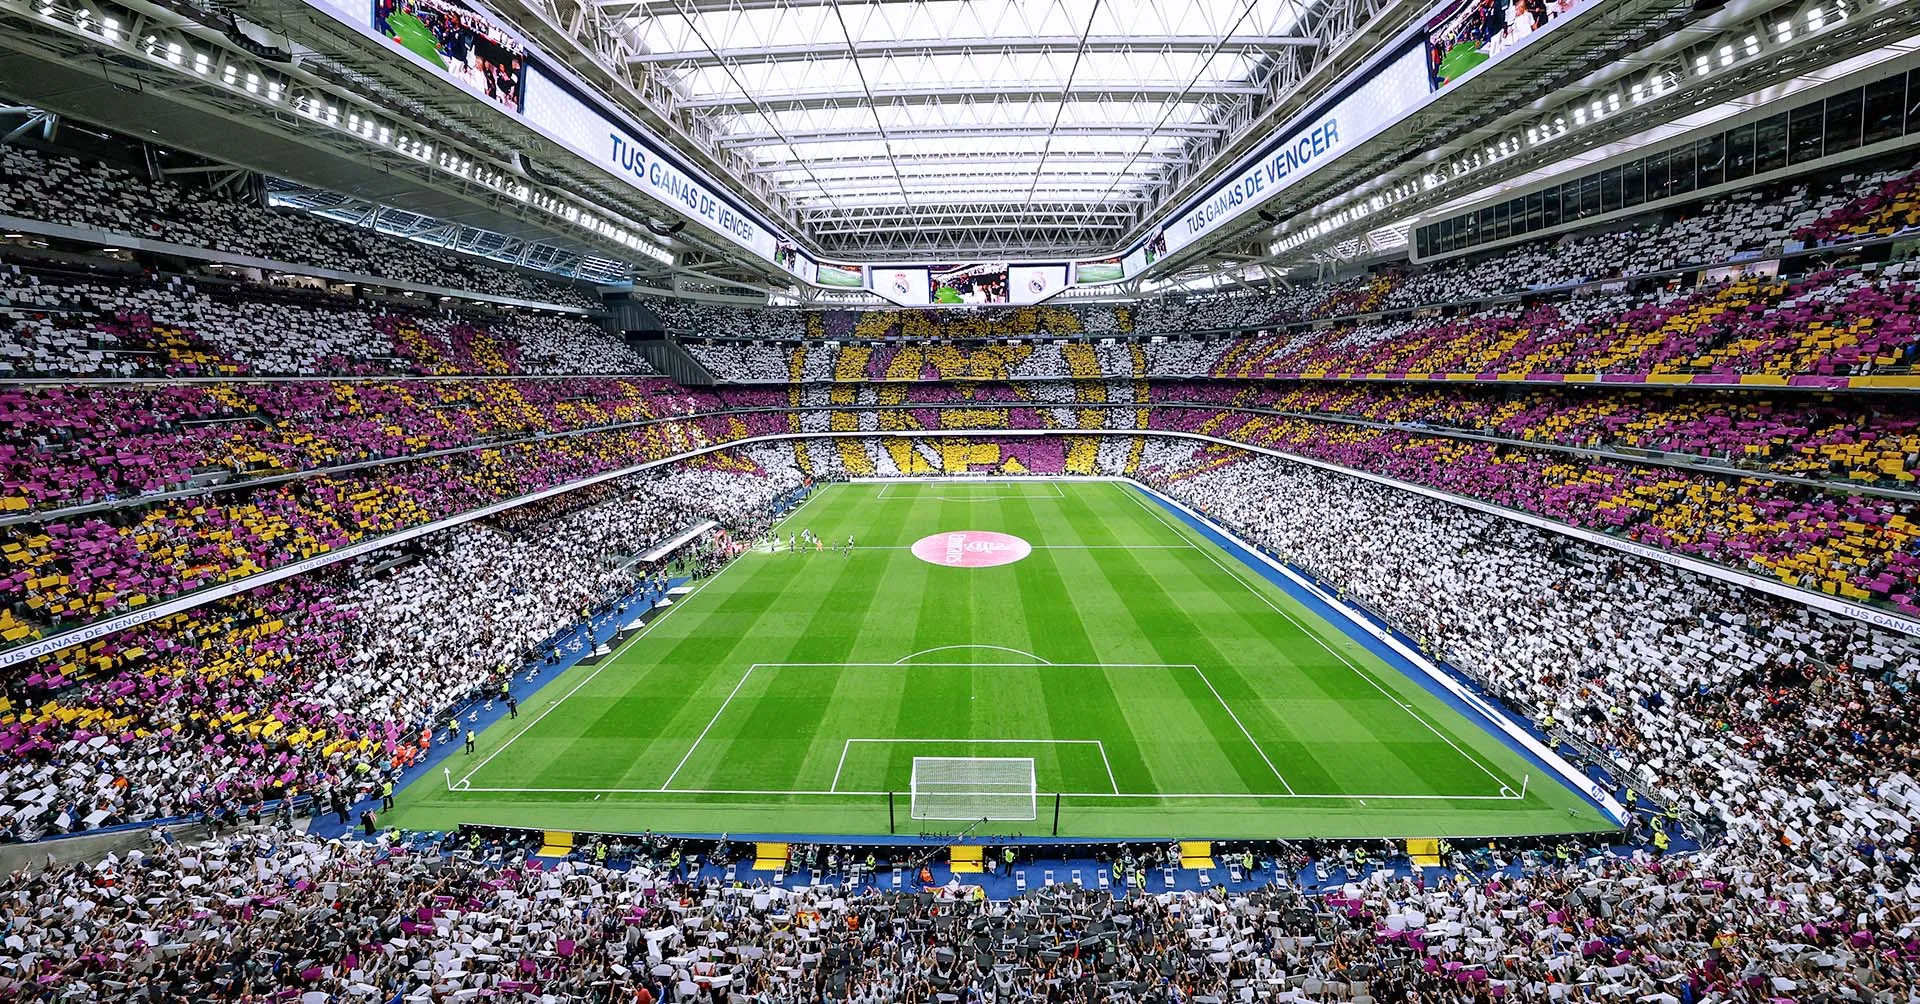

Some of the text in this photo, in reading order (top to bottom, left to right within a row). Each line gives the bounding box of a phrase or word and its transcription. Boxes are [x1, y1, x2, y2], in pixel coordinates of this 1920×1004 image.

[609, 133, 754, 242] TUS GANAS DE VENCER
[1186, 118, 1339, 235] TUS GANAS DE VENCER
[1646, 551, 1682, 565] VENCER
[0, 610, 158, 665] US GANAS DE VENCER
[1842, 606, 1869, 620] TUS
